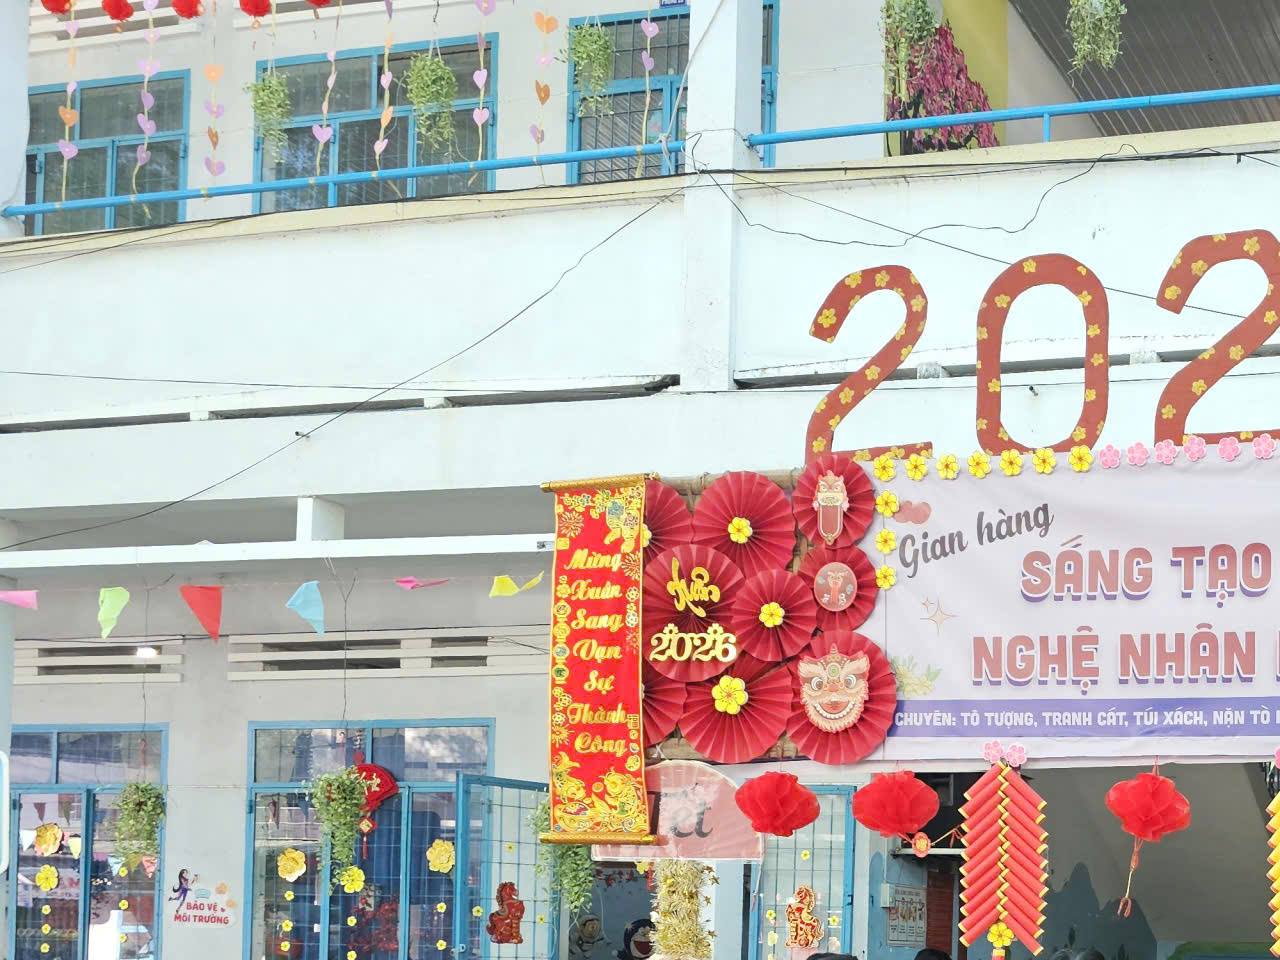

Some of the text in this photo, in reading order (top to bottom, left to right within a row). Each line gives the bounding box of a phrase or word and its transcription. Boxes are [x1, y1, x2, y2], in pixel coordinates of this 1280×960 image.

[898, 503, 1054, 578] Gian hàng
[1020, 534, 1272, 608] SÁNG TẠO
[570, 579, 623, 601] Xuân
[570, 608, 625, 633] Sang
[572, 638, 623, 664] Vạn
[649, 631, 738, 663] 2026
[972, 625, 1100, 695] NGHỆ
[1118, 623, 1256, 685] NHÂN
[583, 669, 615, 695] Sự
[566, 702, 628, 725] Thành
[894, 709, 957, 727] CHUYÊN:
[960, 709, 980, 726] TÔ
[983, 709, 1038, 729] TƯỢNG,
[1041, 710, 1092, 726] TRANH
[1097, 706, 1129, 728] CÁT,
[1132, 706, 1159, 726] TÚI
[1162, 705, 1208, 727] XÁCH,
[1212, 707, 1245, 728] NẶN
[1249, 704, 1271, 725] TÒ
[573, 731, 628, 758] Công
[174, 912, 229, 925] MÔI TRƯỜNG
[186, 900, 218, 914] BẢO VỆ
